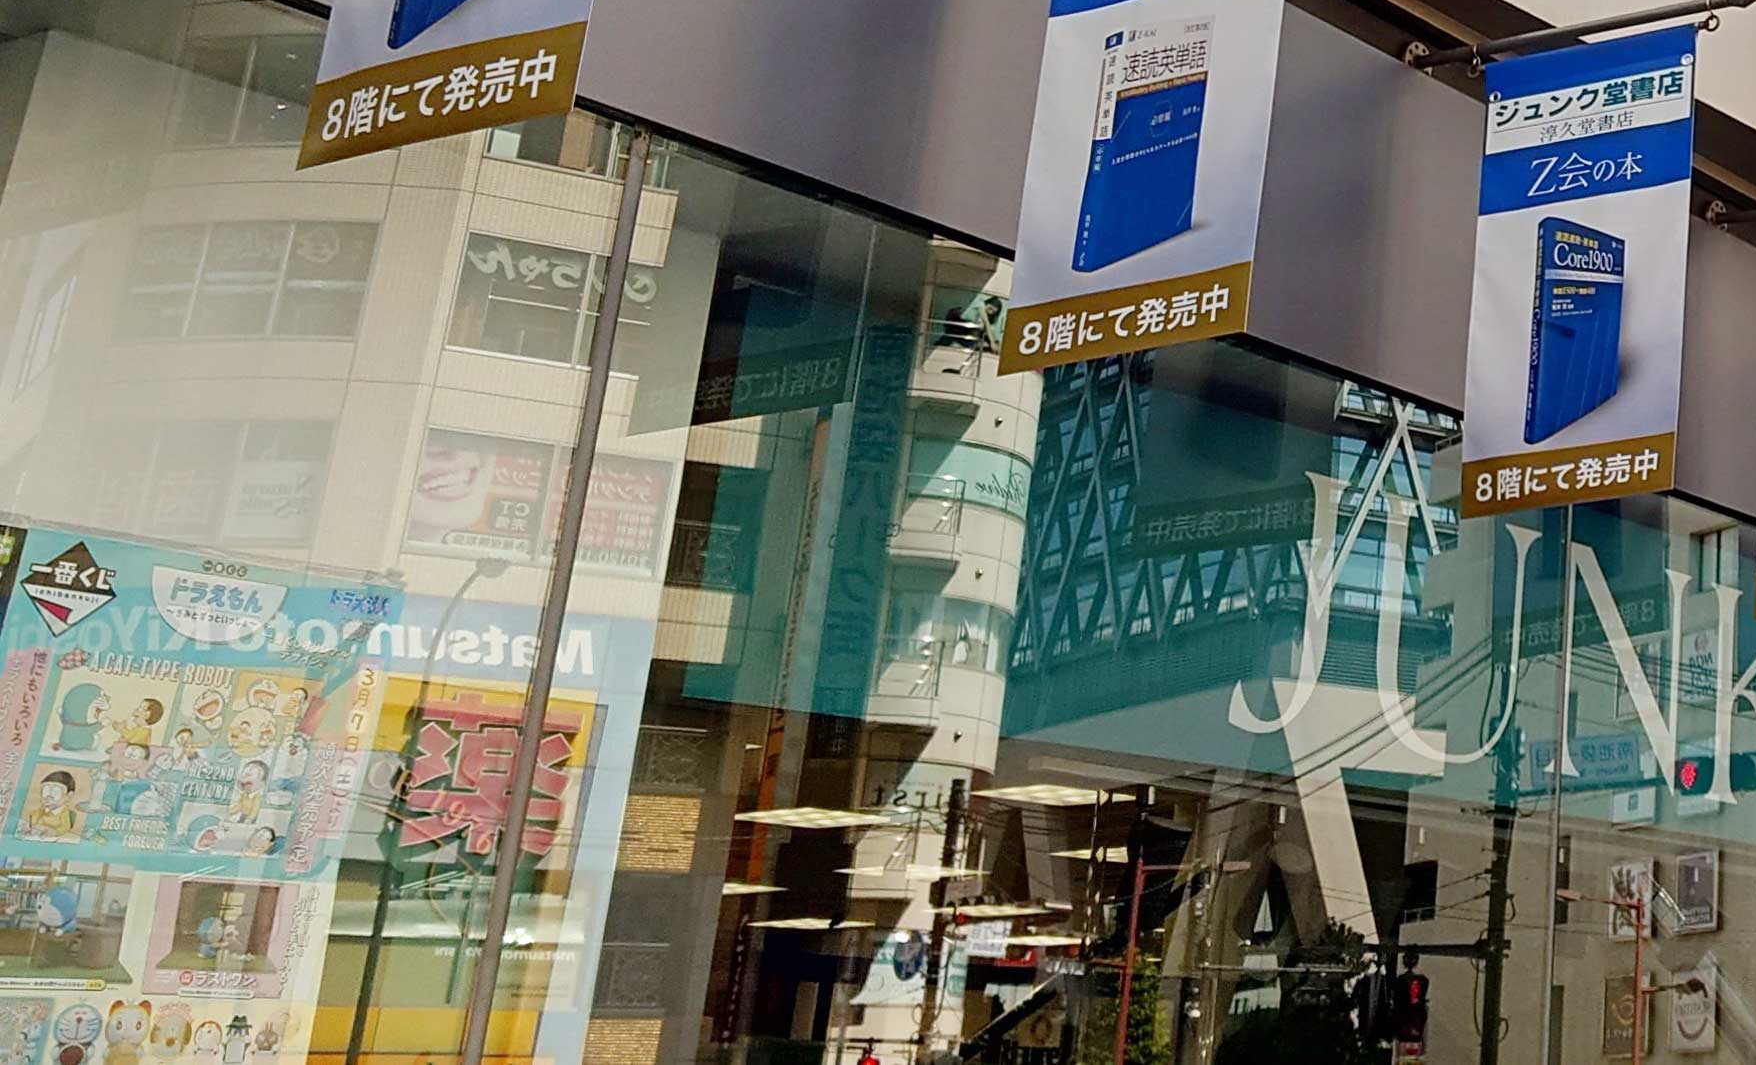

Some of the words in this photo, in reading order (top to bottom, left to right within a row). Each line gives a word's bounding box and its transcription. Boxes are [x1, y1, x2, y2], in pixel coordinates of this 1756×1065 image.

[1121, 40, 1208, 84] 速読英単語
[321, 48, 556, 142] 8階にて発売中
[1494, 69, 1685, 126] ジュンク堂書店
[1539, 111, 1634, 142] 淳久堂書店
[1527, 151, 1643, 197] Z会の本
[1553, 242, 1614, 273] Core1900
[1018, 283, 1230, 356] 8階にて発売中
[1475, 448, 1660, 503] 8階にて発売中
[30, 560, 117, 590] 一番くじ
[170, 576, 263, 614] ドラえもん
[90, 651, 99, 671] A
[101, 652, 180, 683] CAT-TYPE
[183, 665, 235, 690] ROBOT
